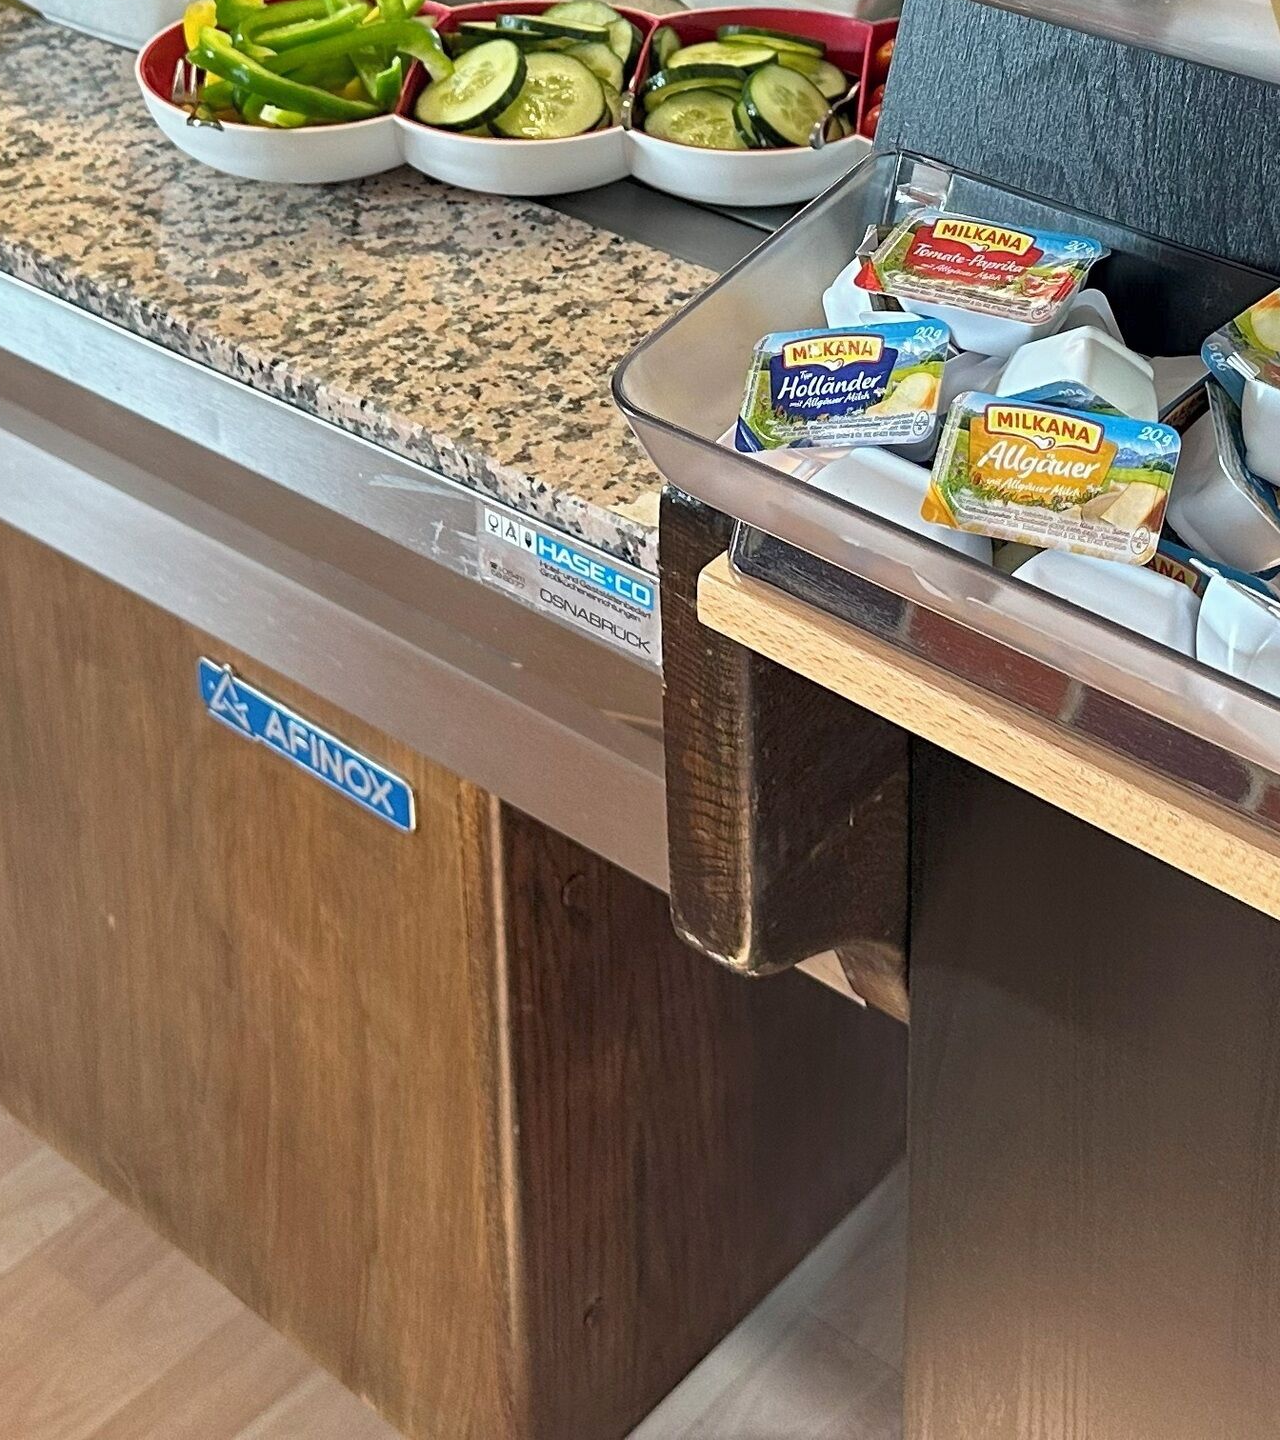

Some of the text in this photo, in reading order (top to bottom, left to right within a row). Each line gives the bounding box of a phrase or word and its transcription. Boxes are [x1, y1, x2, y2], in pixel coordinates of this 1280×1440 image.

[941, 223, 1023, 251] MILKANA
[912, 242, 1025, 274] Tomate-Paprika
[777, 373, 882, 402] Holländer
[789, 391, 870, 410] mit Allgäuer Milch
[996, 411, 1091, 445] MILKANA
[976, 440, 1101, 480] Allgäuer
[999, 477, 1050, 494] Allgäuer
[1050, 483, 1081, 497] Milch
[539, 587, 652, 654] OSNABRÜCK
[264, 710, 395, 817] AFINOX
